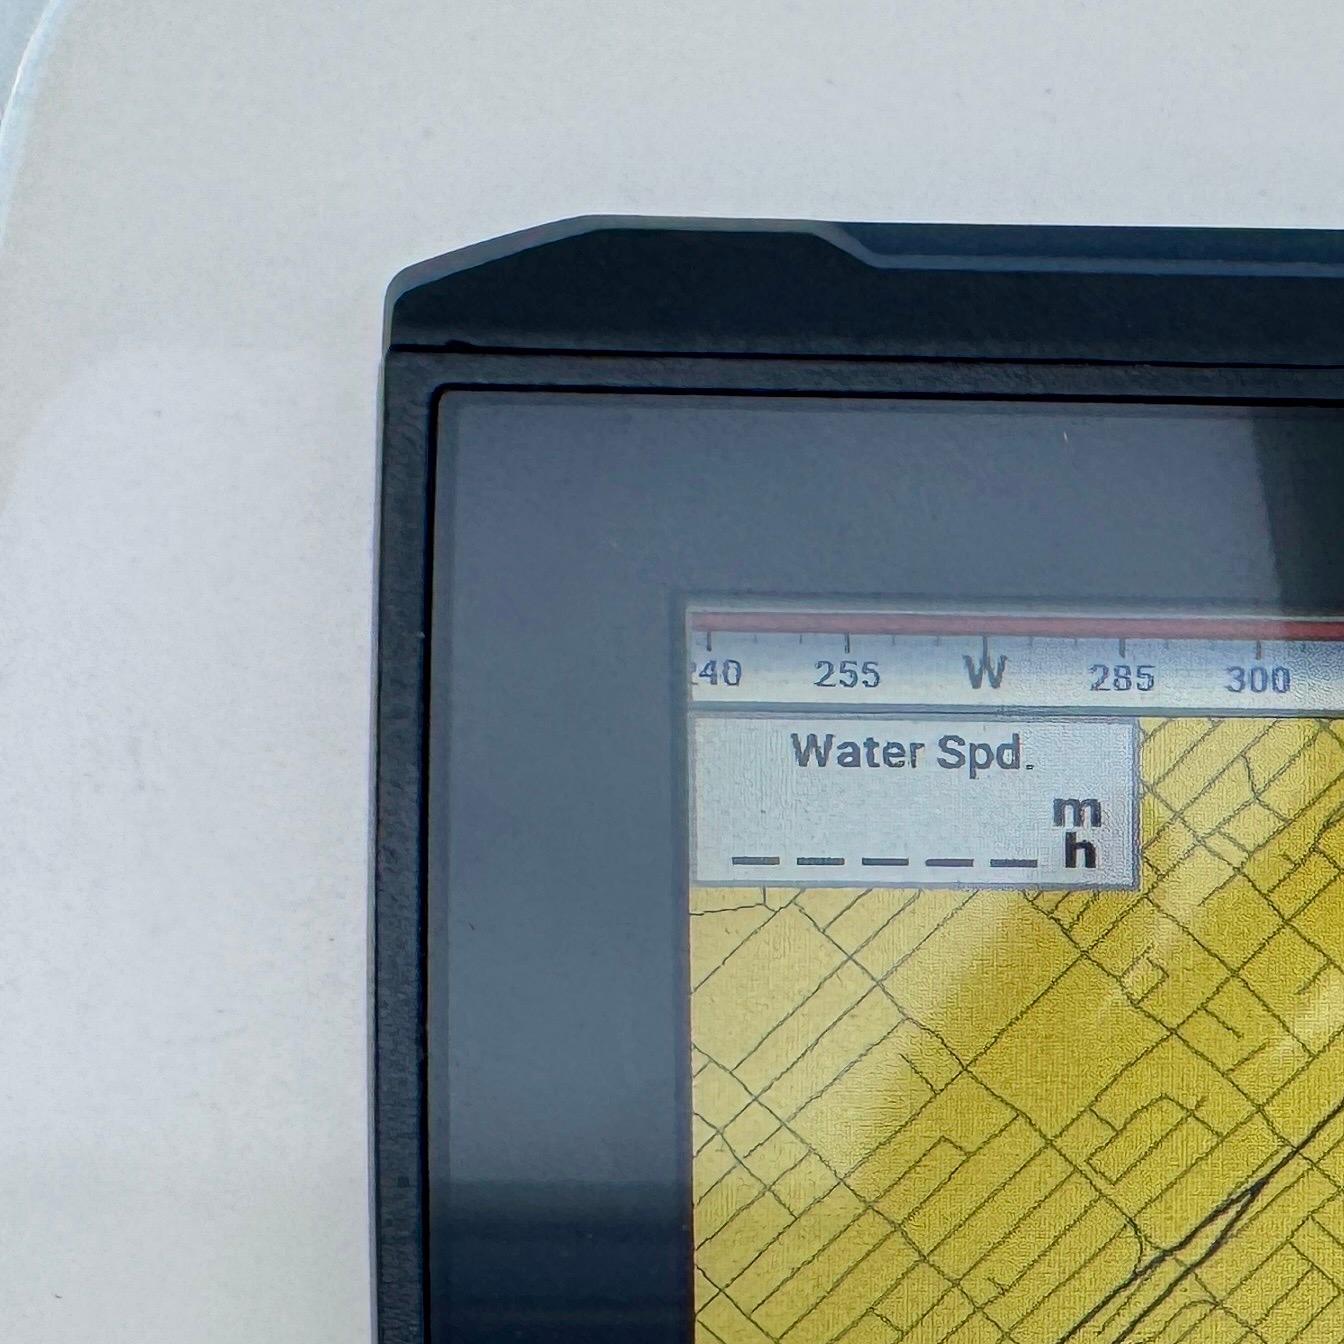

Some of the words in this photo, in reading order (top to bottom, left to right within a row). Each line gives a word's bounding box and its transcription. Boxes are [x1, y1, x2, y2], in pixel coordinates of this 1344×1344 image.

[815, 659, 881, 689] 255
[963, 653, 1008, 691] W
[1090, 663, 1156, 692] 285
[1225, 664, 1291, 694] 300
[792, 731, 925, 769] Water
[936, 731, 1034, 780] Spd.
[1053, 798, 1102, 828] m
[1065, 831, 1098, 870] h
